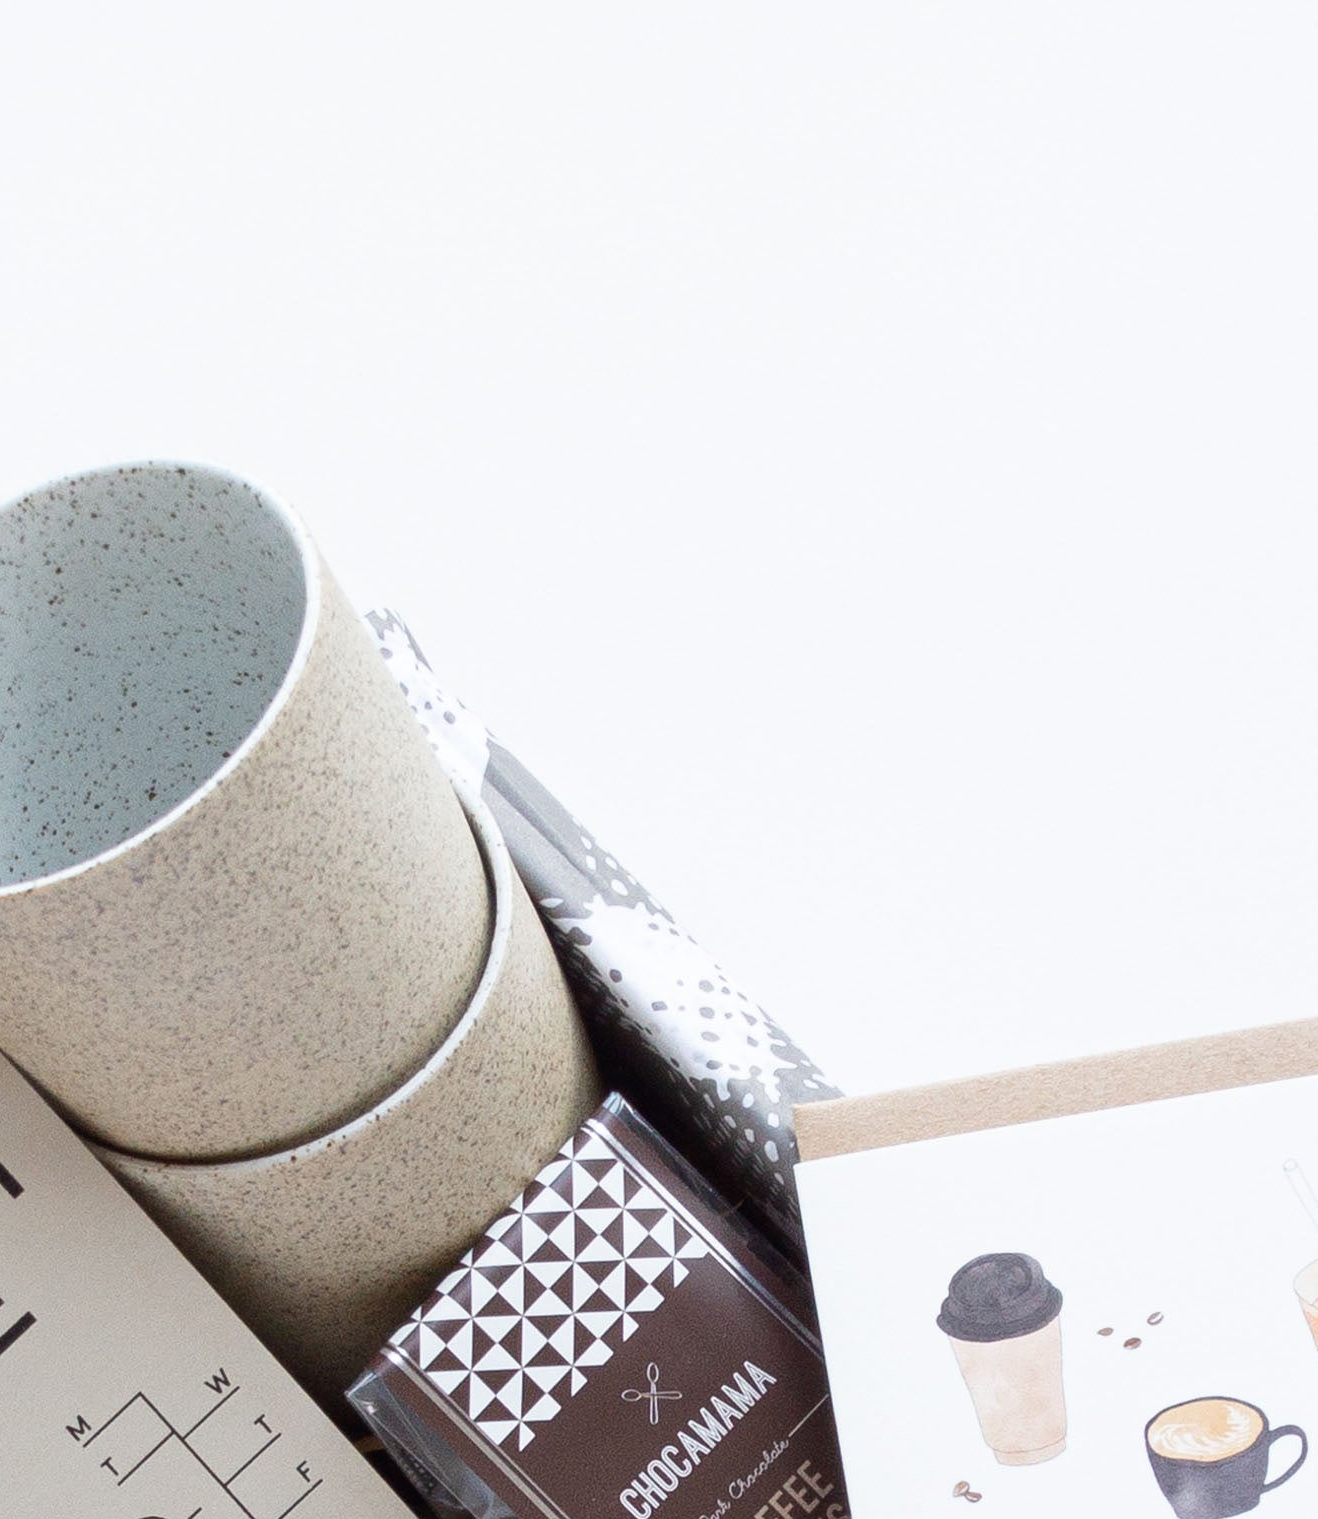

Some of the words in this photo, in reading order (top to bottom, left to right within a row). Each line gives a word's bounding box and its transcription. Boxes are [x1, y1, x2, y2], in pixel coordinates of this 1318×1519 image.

[204, 1368, 231, 1394] W
[66, 1415, 92, 1441] M
[254, 1414, 272, 1433] T
[100, 1457, 119, 1476] T
[296, 1461, 311, 1482] F
[728, 1438, 790, 1499] Chocolate
